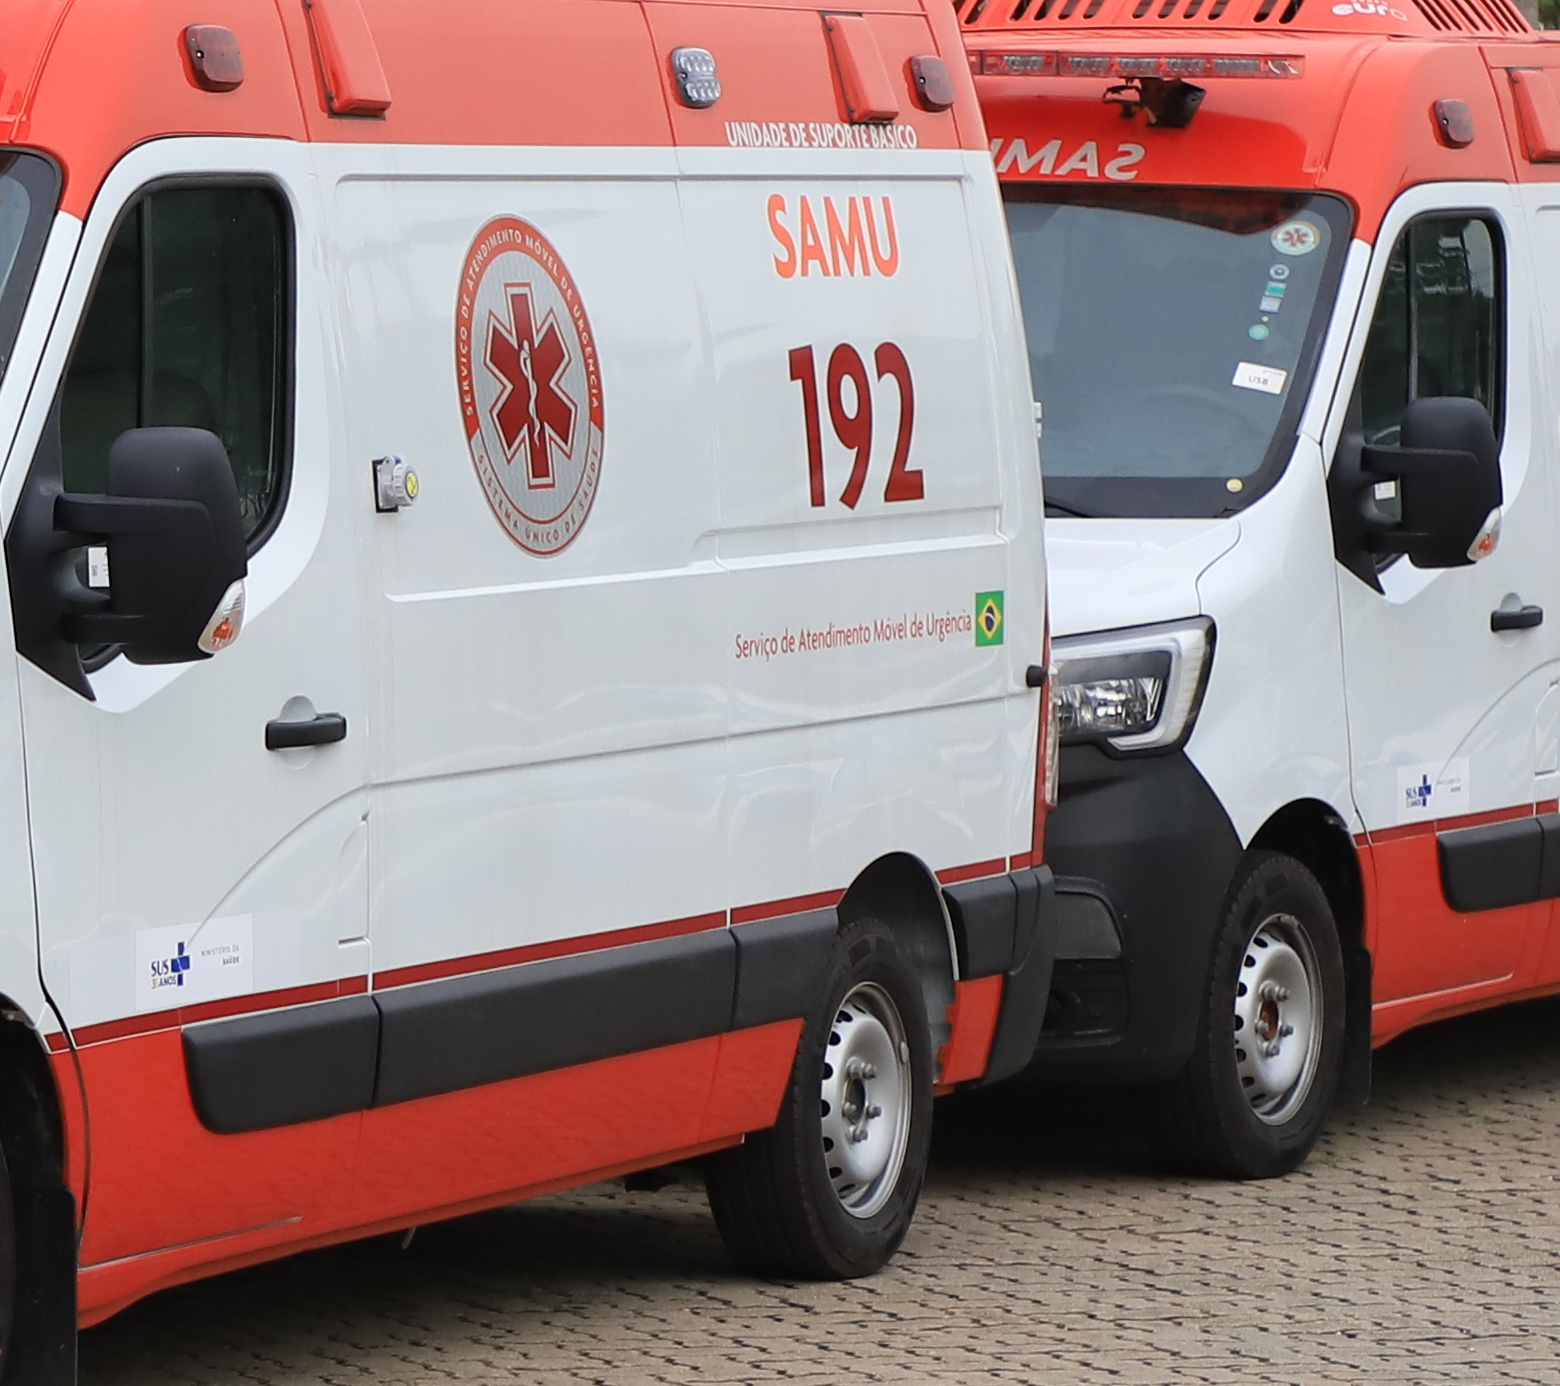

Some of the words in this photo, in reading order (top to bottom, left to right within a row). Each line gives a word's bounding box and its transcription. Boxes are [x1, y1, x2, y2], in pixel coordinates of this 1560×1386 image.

[1332, 2, 1410, 22] euro
[724, 121, 789, 148] UNIDADE
[788, 122, 809, 148] DE
[809, 122, 870, 149] SUPORTE
[466, 228, 522, 291] ATENDIMENTO
[525, 235, 560, 276] MÓVEL
[767, 193, 899, 279] SAMU
[461, 294, 472, 319] DE
[560, 276, 574, 301] DE
[459, 326, 474, 416] SERVIÇO
[788, 341, 925, 510] 192
[478, 454, 519, 529] SISTEMA
[525, 524, 560, 544] ÚNICO
[564, 513, 577, 533] DE
[735, 632, 778, 663] Serviço
[781, 627, 796, 654] de
[798, 622, 871, 652] Atendimento
[873, 616, 908, 642] Móvel
[910, 613, 924, 638] de
[926, 609, 972, 643] Urgência
[151, 959, 169, 977] SUS
